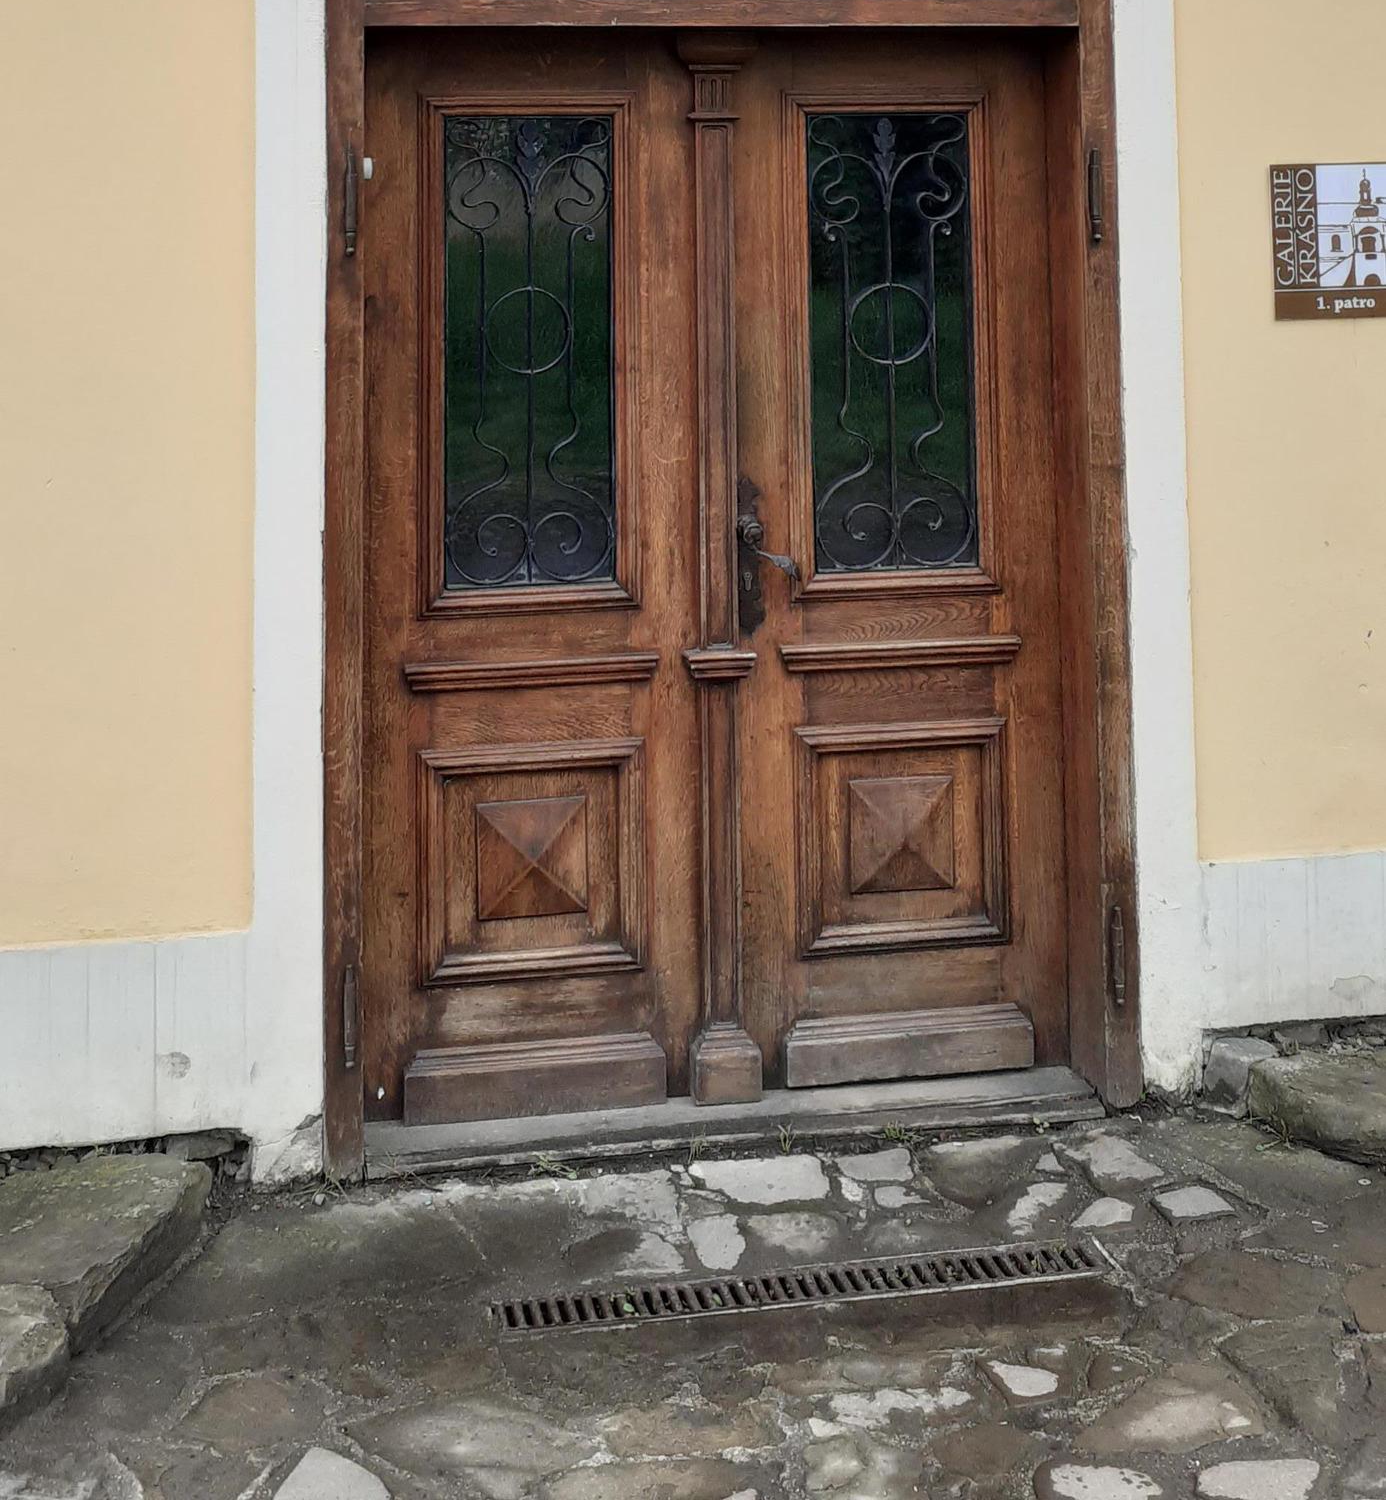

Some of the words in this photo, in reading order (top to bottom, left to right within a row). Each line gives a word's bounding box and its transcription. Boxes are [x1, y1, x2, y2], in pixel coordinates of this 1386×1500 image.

[1273, 168, 1296, 286] GALERIE
[1295, 168, 1318, 285] KRÁSNO
[1316, 296, 1331, 310] 1.
[1334, 296, 1376, 313] patro
